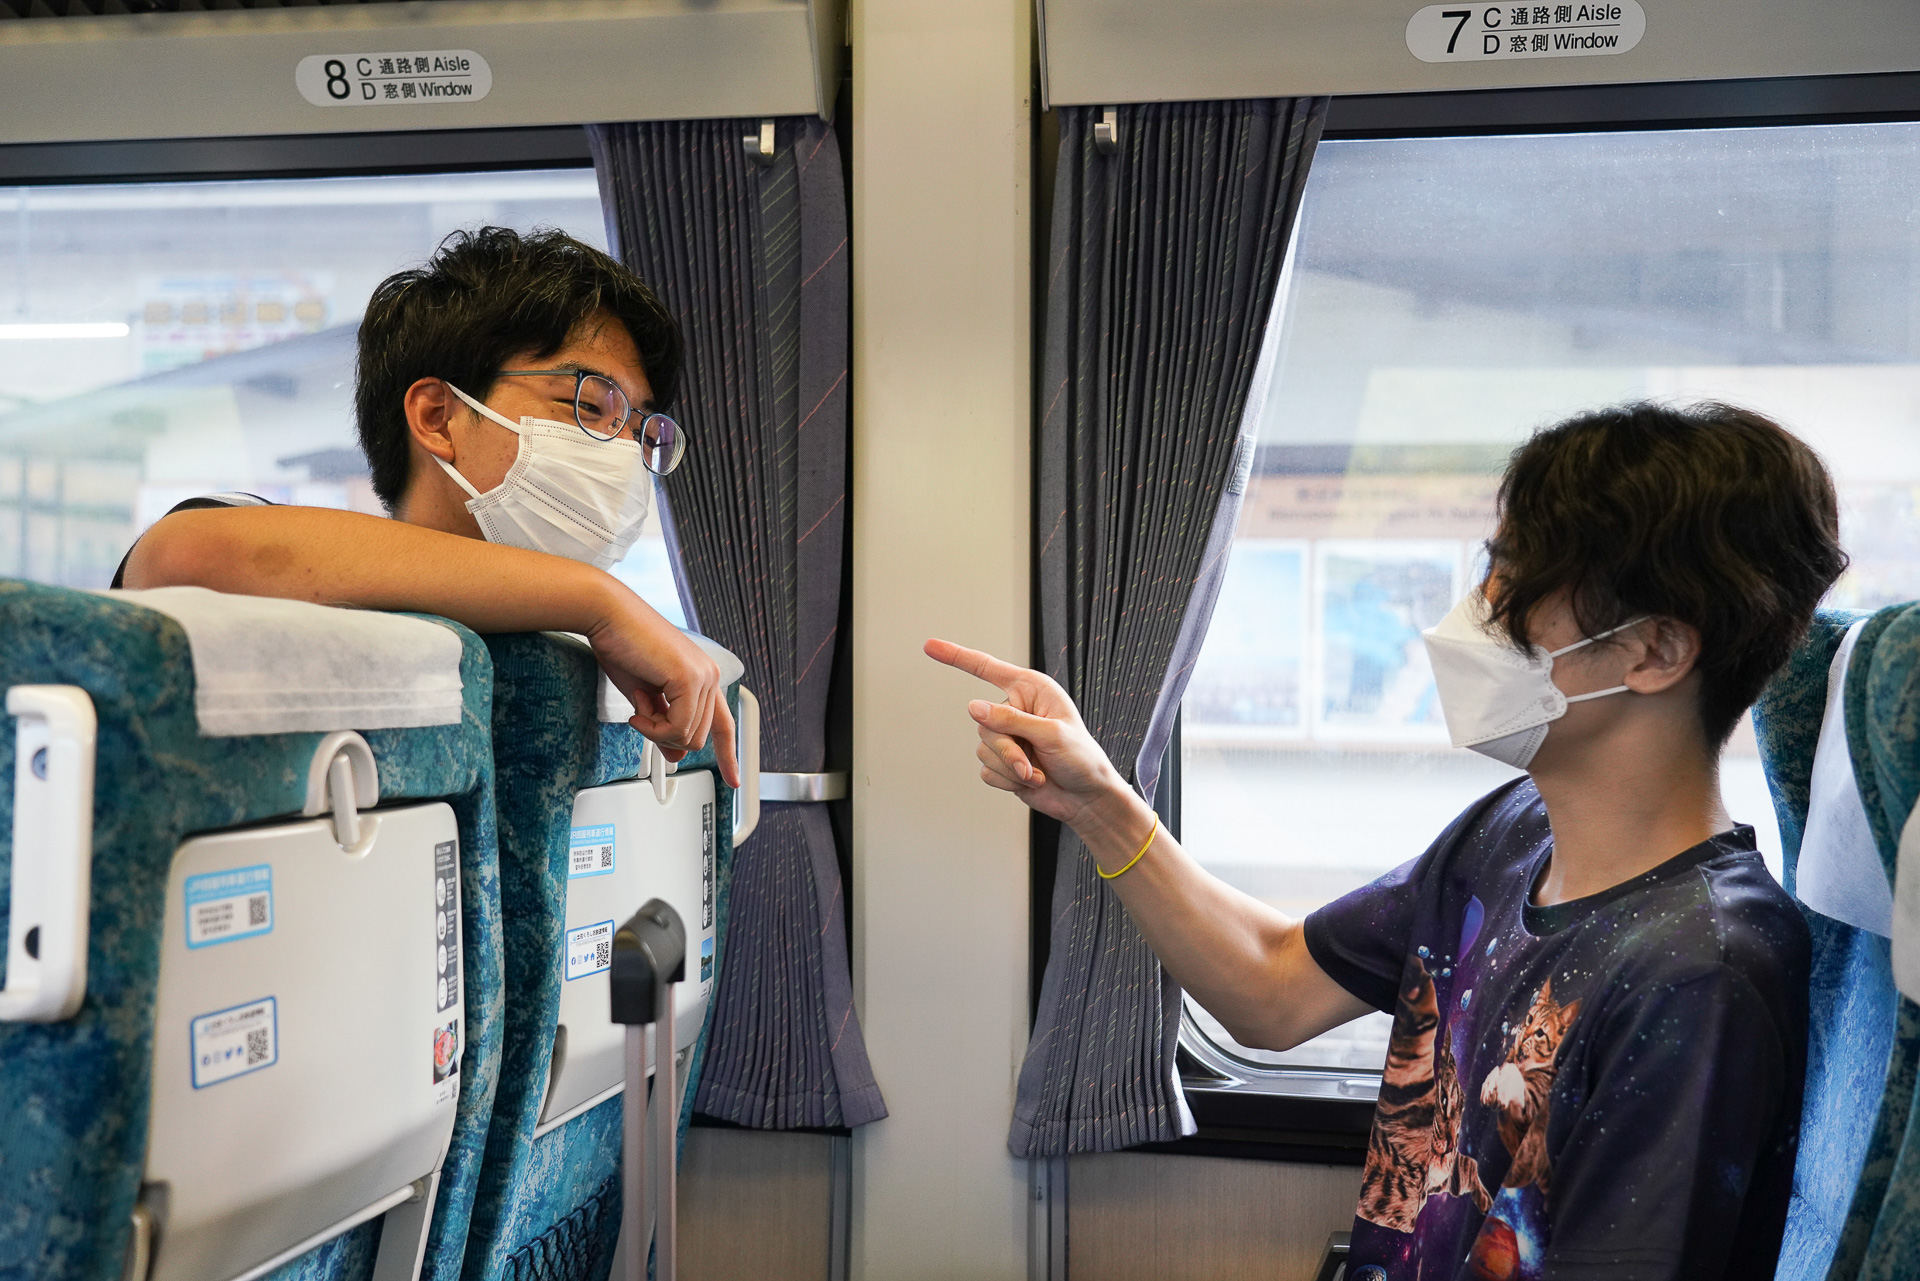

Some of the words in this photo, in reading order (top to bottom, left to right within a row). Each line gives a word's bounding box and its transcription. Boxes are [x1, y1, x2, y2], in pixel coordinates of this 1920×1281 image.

[1483, 7, 1502, 28] C
[1511, 5, 1572, 26] 通路側
[1576, 4, 1622, 22] Aisle
[1442, 10, 1472, 54] 7
[1483, 35, 1501, 55] D
[1510, 33, 1549, 53] 窓側
[1554, 33, 1619, 50] Window
[356, 57, 373, 77] C
[380, 56, 430, 75] 通路側
[434, 56, 470, 72] Aisle
[324, 59, 351, 100] 8
[361, 82, 377, 100] D
[383, 82, 417, 99] 窓側
[419, 82, 472, 97] Window
